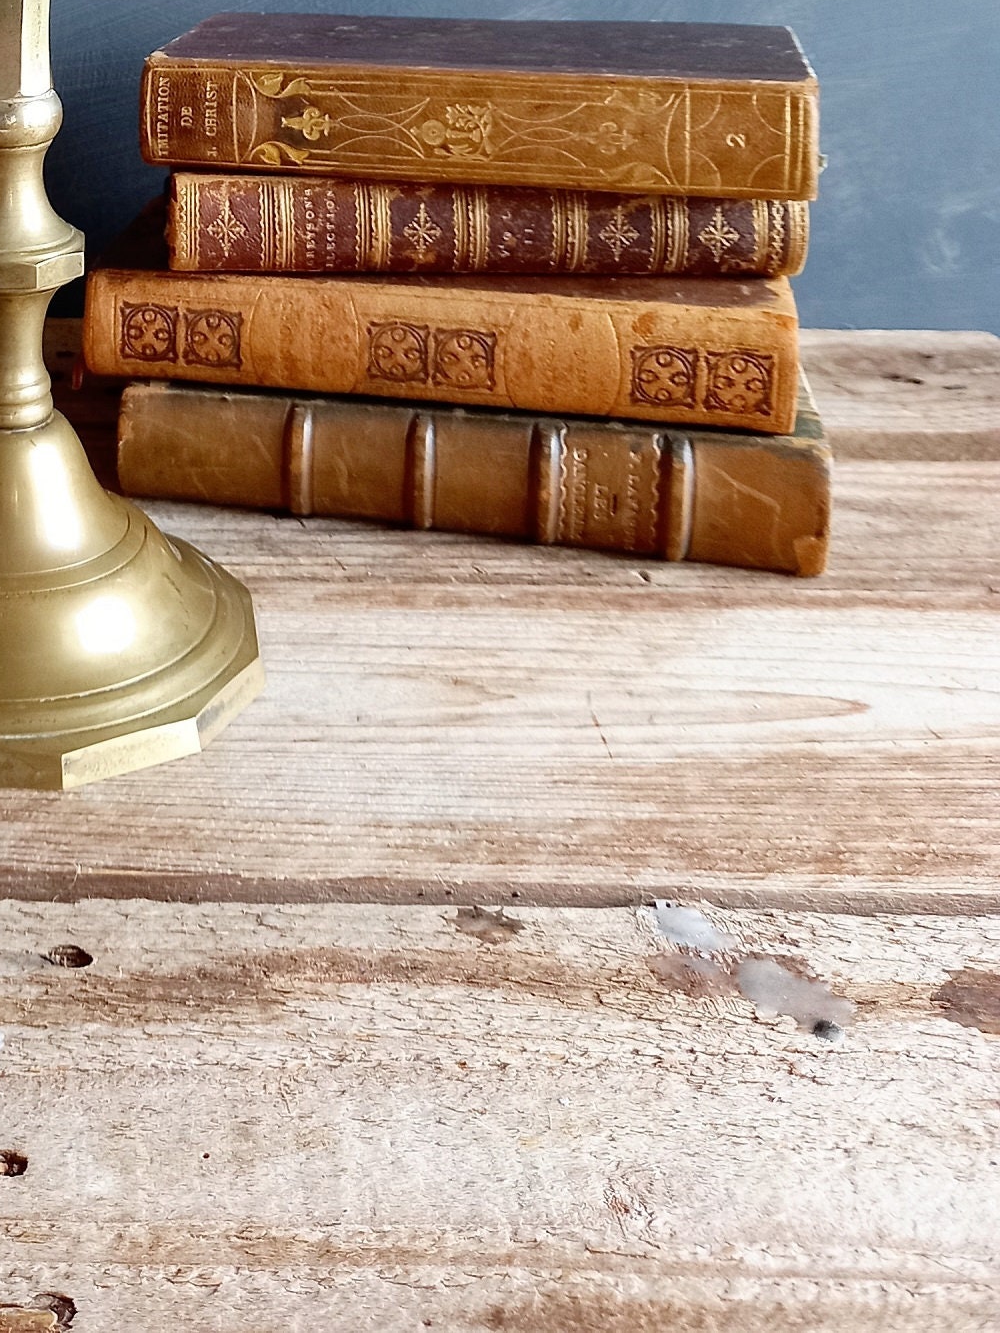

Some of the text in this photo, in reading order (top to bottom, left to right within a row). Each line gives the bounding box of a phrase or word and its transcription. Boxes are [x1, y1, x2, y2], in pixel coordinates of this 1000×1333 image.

[157, 76, 170, 156] IMITATION
[180, 106, 193, 128] DE
[204, 80, 218, 137] CHRIST
[725, 132, 746, 149] 2
